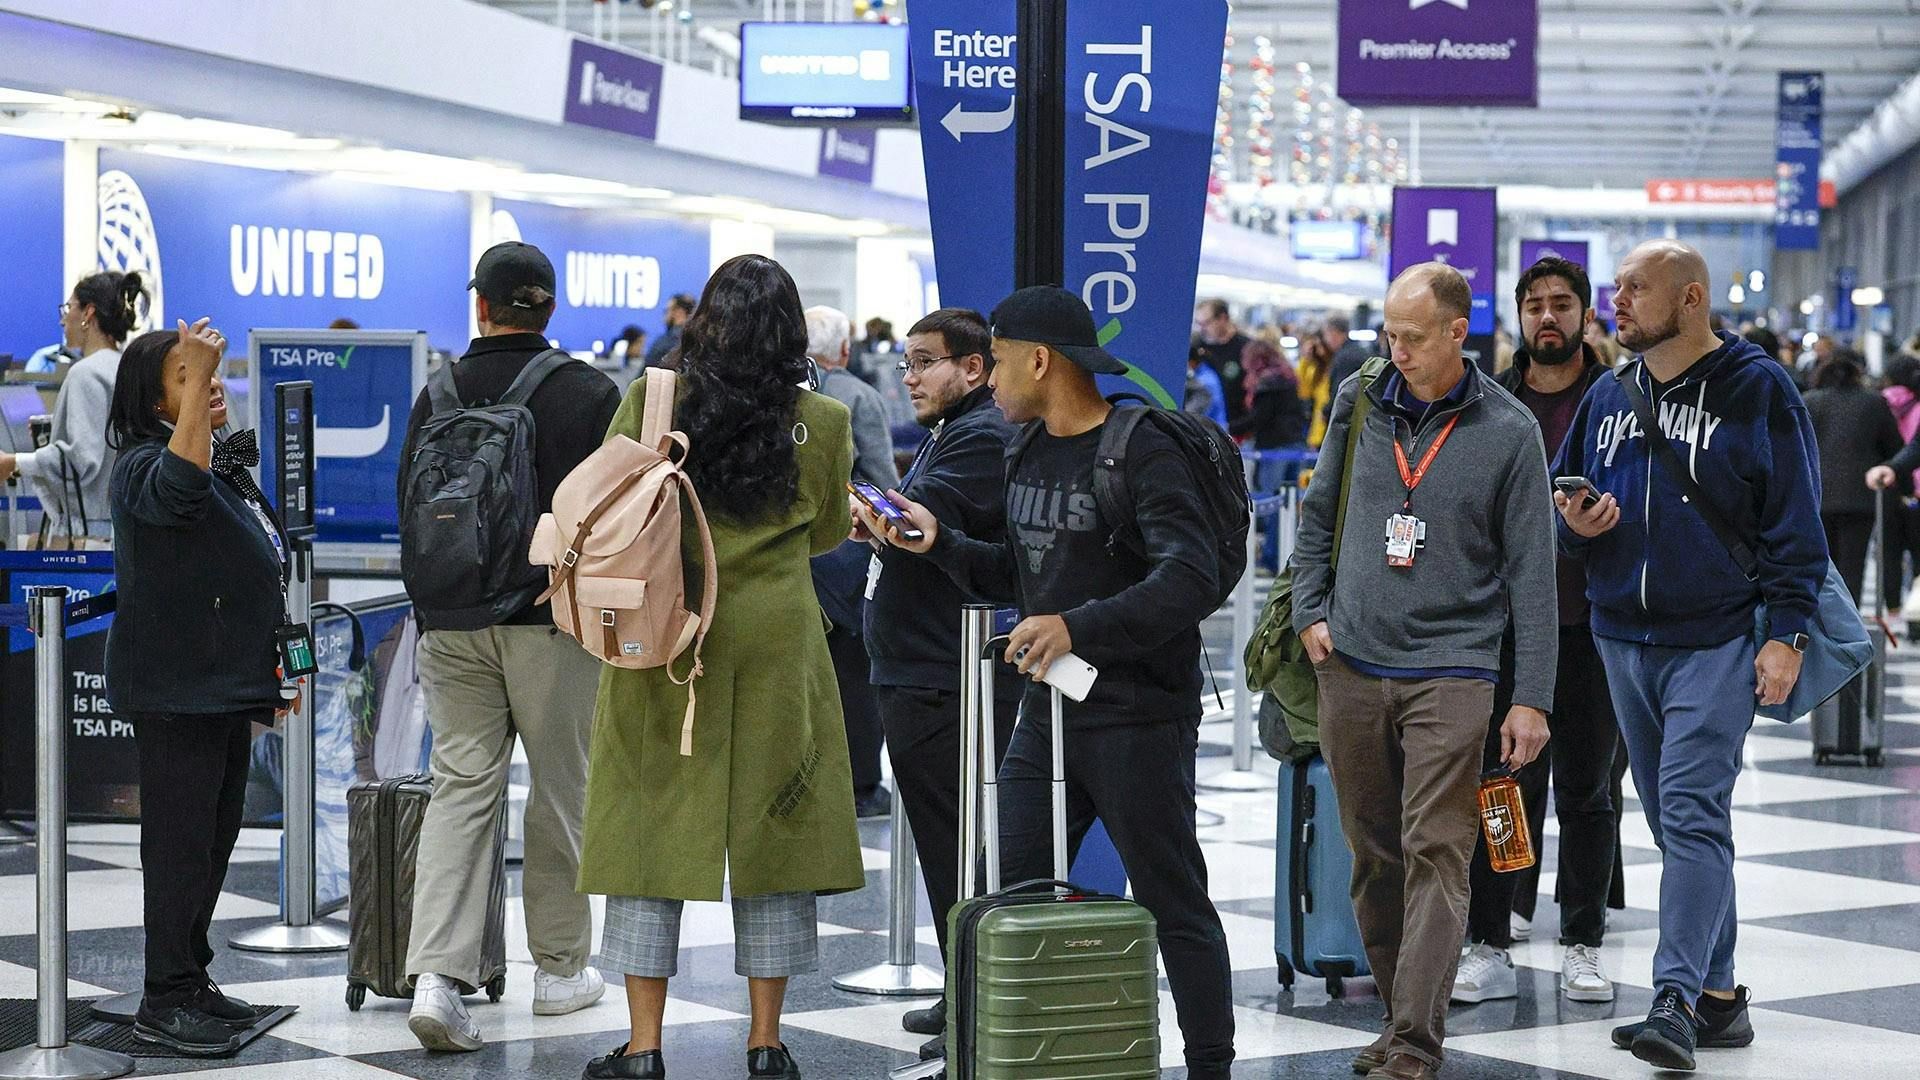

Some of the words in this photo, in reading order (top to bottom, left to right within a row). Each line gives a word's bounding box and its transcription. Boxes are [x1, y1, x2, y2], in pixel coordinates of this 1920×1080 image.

[934, 30, 1016, 57] Enter
[1359, 39, 1436, 60] Premier
[943, 61, 1016, 88] Here
[1084, 25, 1152, 170] TSA
[230, 224, 384, 299] UNITED
[1082, 194, 1150, 313] Pre
[566, 250, 660, 309] UNITED
[270, 348, 303, 366] TSA
[306, 348, 336, 367] Pre
[1658, 401, 1721, 451] NAVY
[74, 694, 88, 713] is
[91, 694, 114, 714] le
[73, 718, 107, 737] TSA
